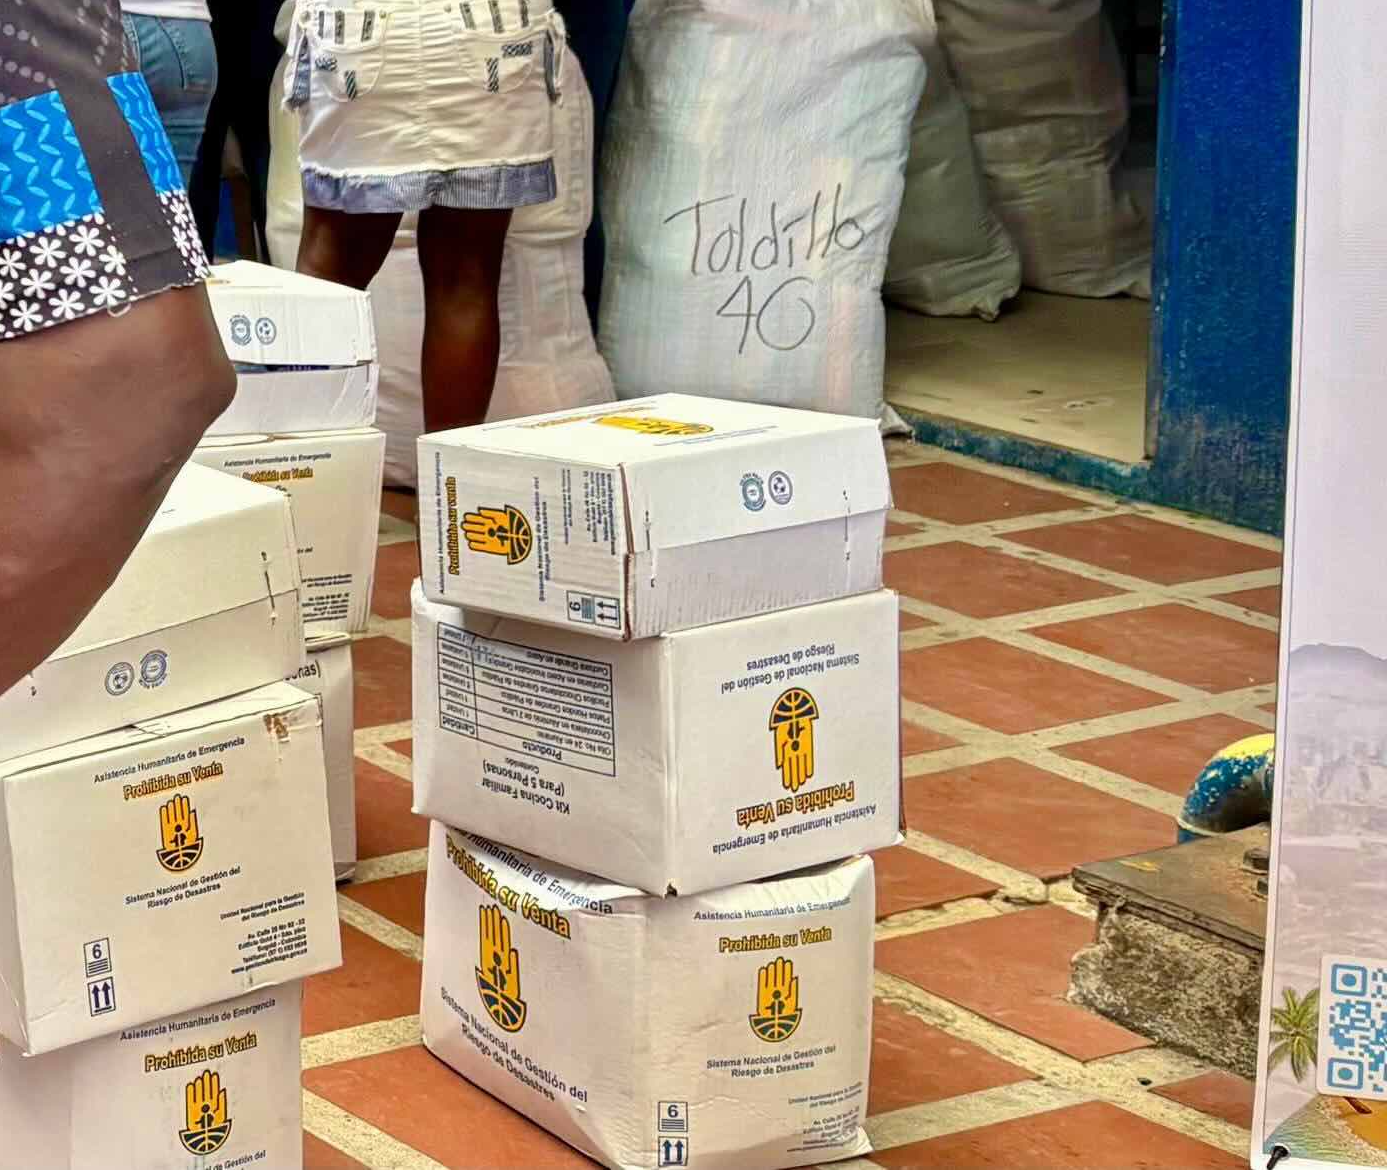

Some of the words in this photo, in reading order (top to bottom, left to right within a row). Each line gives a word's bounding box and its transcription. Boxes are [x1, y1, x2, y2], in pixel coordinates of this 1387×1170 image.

[716, 276, 816, 354] 40
[569, 600, 581, 612] 6
[792, 650, 803, 661] de
[805, 643, 836, 658] Riesgo
[826, 653, 860, 669] Sistema
[746, 653, 791, 672] Desastres
[786, 661, 825, 677] Nacional
[738, 672, 772, 689] Gestión
[773, 669, 785, 680] de
[721, 682, 736, 695] del
[94, 766, 136, 784] Asistencia
[137, 753, 186, 774] Humanitaria
[187, 748, 197, 759] de
[199, 736, 245, 757] Emergencia
[522, 740, 563, 761] Producto
[123, 776, 176, 801] Prohibida
[176, 772, 192, 787] su
[192, 761, 224, 782] Venta
[482, 759, 529, 787] Personas)
[530, 778, 537, 789] 5
[482, 777, 519, 799] Familiar
[538, 781, 565, 797] (Para
[794, 780, 856, 815] Prohibida
[520, 790, 554, 810] Cocina
[554, 801, 570, 815] Kit
[776, 798, 793, 817] su
[736, 801, 775, 830] Venta
[834, 803, 877, 824] Asistencia
[767, 826, 779, 841] de
[780, 815, 833, 838] Humanitaria
[712, 834, 766, 855] Emergencia
[125, 891, 155, 906] Sistema
[156, 881, 188, 898] Nacional
[189, 878, 199, 888] de
[200, 870, 229, 887] Gestión
[230, 865, 241, 877] del
[147, 894, 174, 910] Riesgo
[175, 893, 184, 903] de
[185, 882, 221, 900] Desastres
[445, 833, 498, 899] Prohibida
[498, 883, 519, 913] su
[520, 890, 572, 940] Venta
[693, 909, 743, 921] Asistencia
[744, 905, 796, 920] Humanitaria
[796, 903, 807, 913] de
[718, 934, 780, 954] Prohibida
[782, 933, 798, 948] su
[799, 925, 833, 945] Venta
[92, 944, 103, 960] 6
[120, 1023, 168, 1041] Asistencia
[169, 1013, 220, 1033] Humanitaria
[221, 1010, 231, 1023] de
[232, 998, 276, 1020] Emergencia
[144, 1043, 207, 1073] Prohibida
[207, 1043, 224, 1061] su
[225, 1031, 258, 1055] Venta
[440, 986, 470, 1024] Sistema
[470, 1013, 510, 1056] Nacional
[511, 1044, 524, 1063] de
[524, 1052, 567, 1091] Gestión
[569, 1084, 588, 1103] del
[460, 1022, 492, 1057] Riesgo
[493, 1049, 505, 1068] de
[506, 1059, 556, 1103] Desastres
[706, 1057, 742, 1070] Sistema
[743, 1052, 781, 1067] Nacional
[782, 1051, 793, 1063] de
[793, 1045, 824, 1060] Gestión
[731, 1064, 761, 1080] Riesgo
[763, 1063, 775, 1076] de
[776, 1059, 815, 1075] Desastres
[667, 1104, 678, 1119] 6
